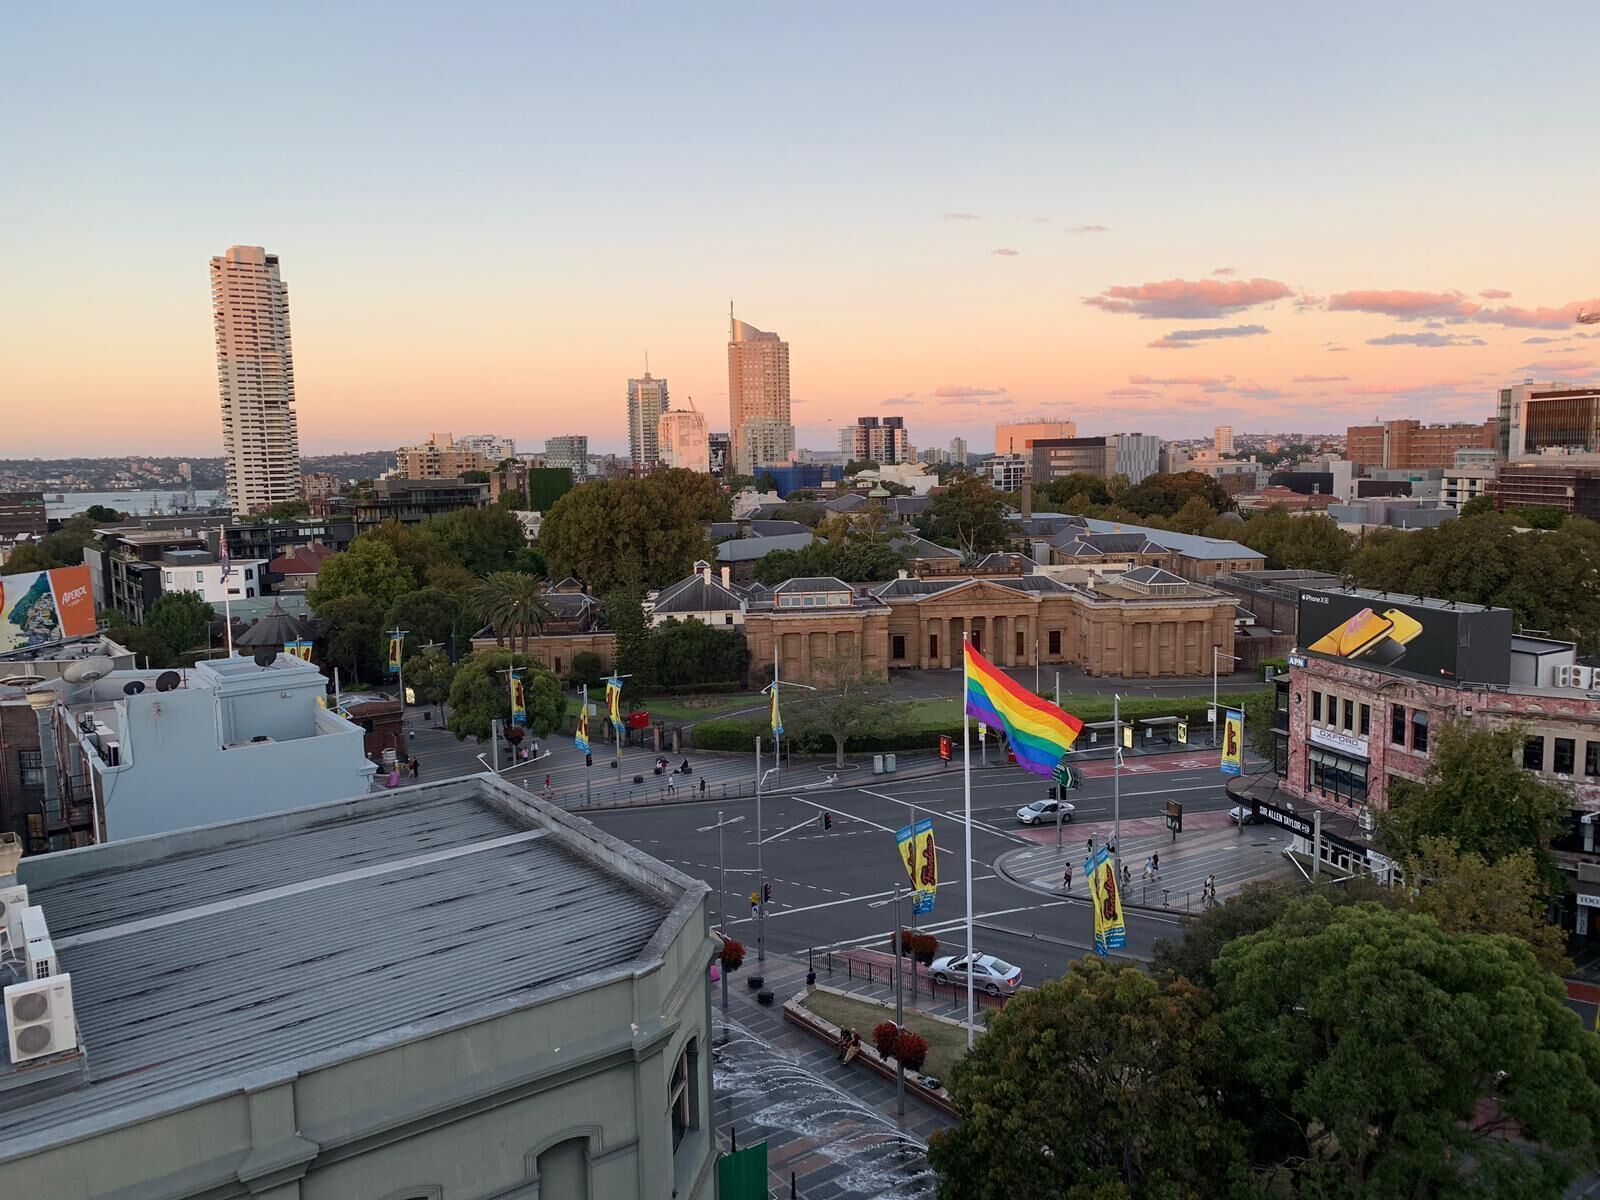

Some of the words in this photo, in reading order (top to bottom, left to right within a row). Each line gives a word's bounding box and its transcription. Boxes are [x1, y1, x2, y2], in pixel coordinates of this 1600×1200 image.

[62, 585, 87, 605] APEROL
[1306, 594, 1320, 603] iPhone
[1289, 657, 1304, 667] APN
[1319, 730, 1359, 747] OXFORD
[1259, 805, 1268, 817] SIR
[1268, 809, 1283, 823] ALLEN
[1283, 815, 1302, 831] TAYLOR
